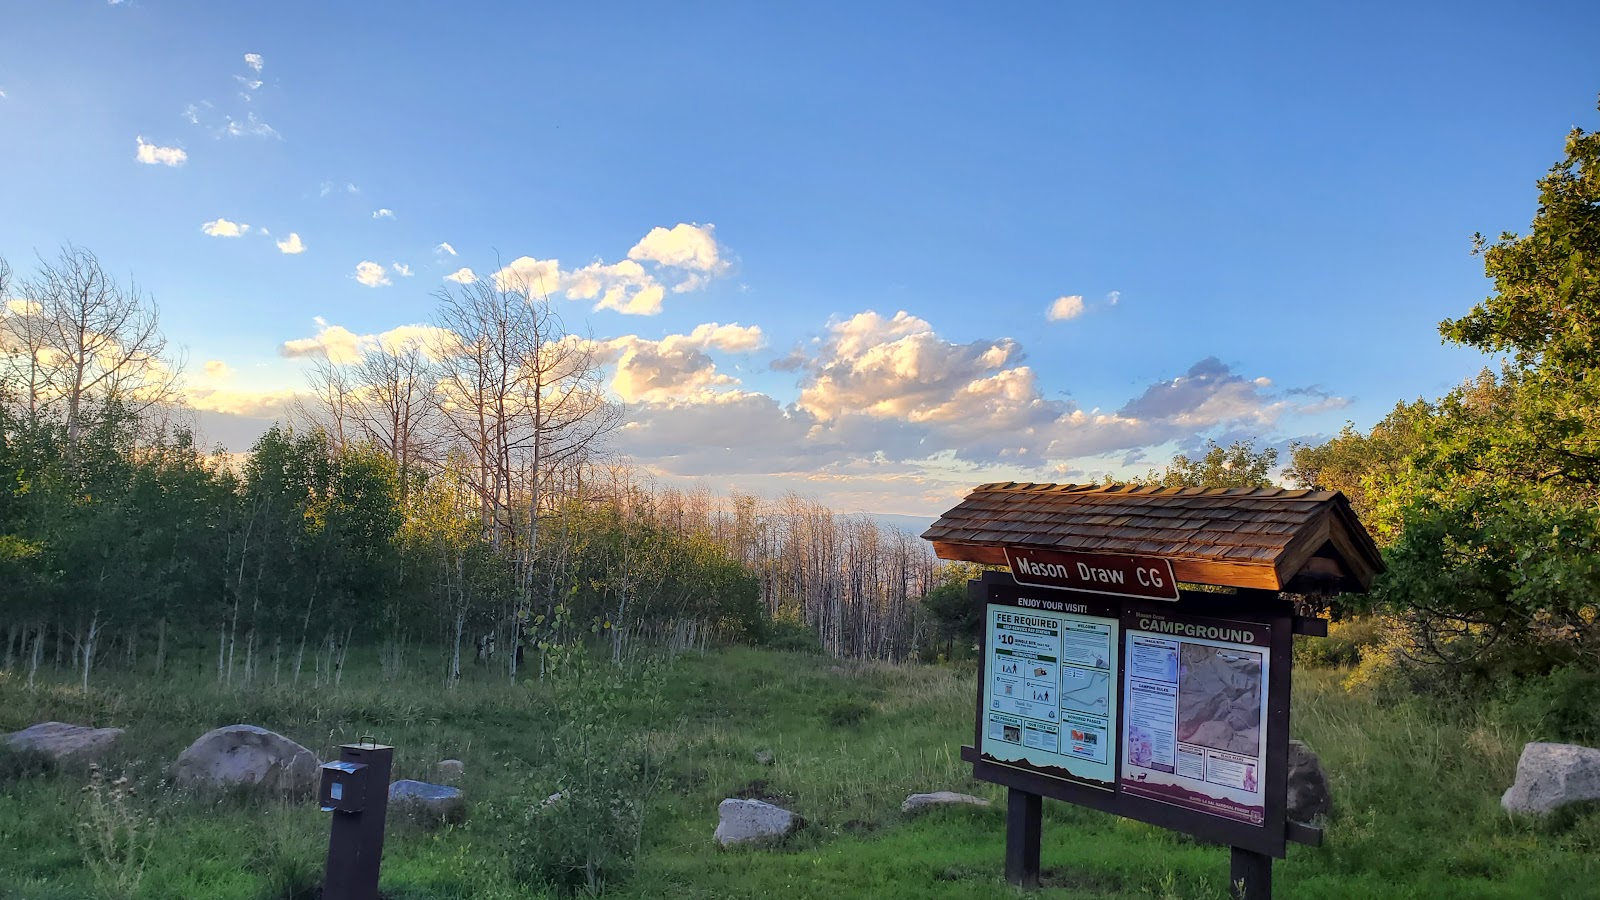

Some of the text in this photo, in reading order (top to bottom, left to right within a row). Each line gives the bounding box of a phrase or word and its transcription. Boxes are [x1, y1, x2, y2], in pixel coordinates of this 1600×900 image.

[1016, 556, 1164, 588] Mason Draw CG
[1018, 597, 1088, 614] ENJOY YOUR VISIT!
[997, 613, 1058, 629] FEE REQUIRED
[1139, 618, 1255, 644] CAMPGROUND
